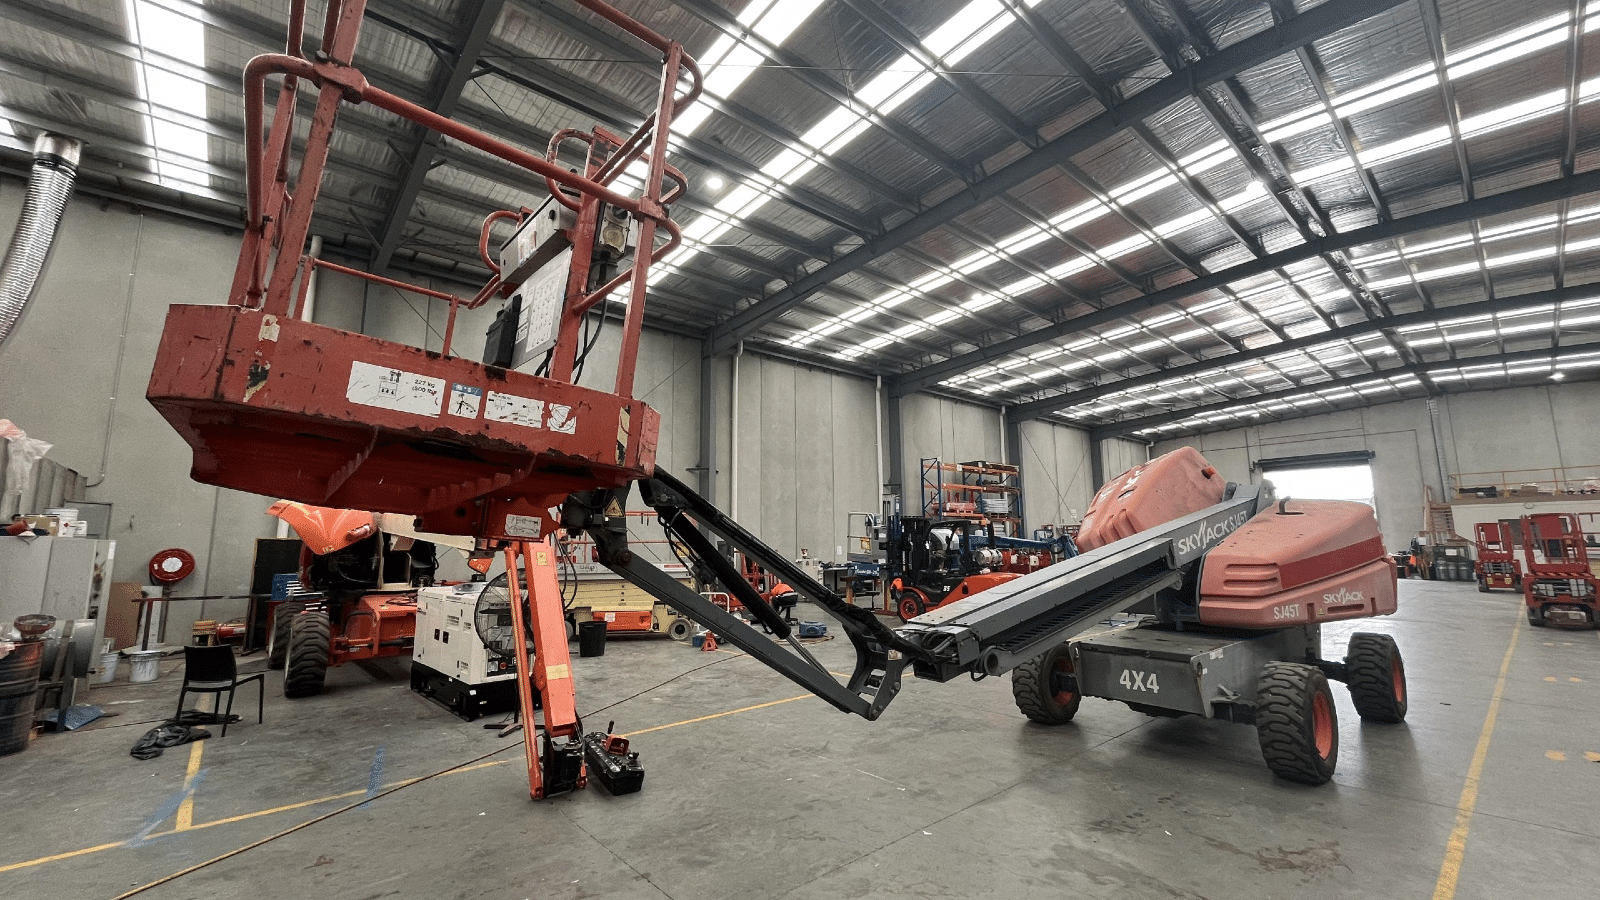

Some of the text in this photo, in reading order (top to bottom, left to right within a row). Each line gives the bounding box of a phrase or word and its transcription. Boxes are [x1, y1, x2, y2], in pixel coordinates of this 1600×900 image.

[414, 378, 427, 386] 227
[1177, 520, 1230, 555] SKYJACK
[1323, 587, 1365, 605] SKYJACK
[1273, 604, 1300, 620] SJ45T
[1119, 669, 1160, 694] 4X4
